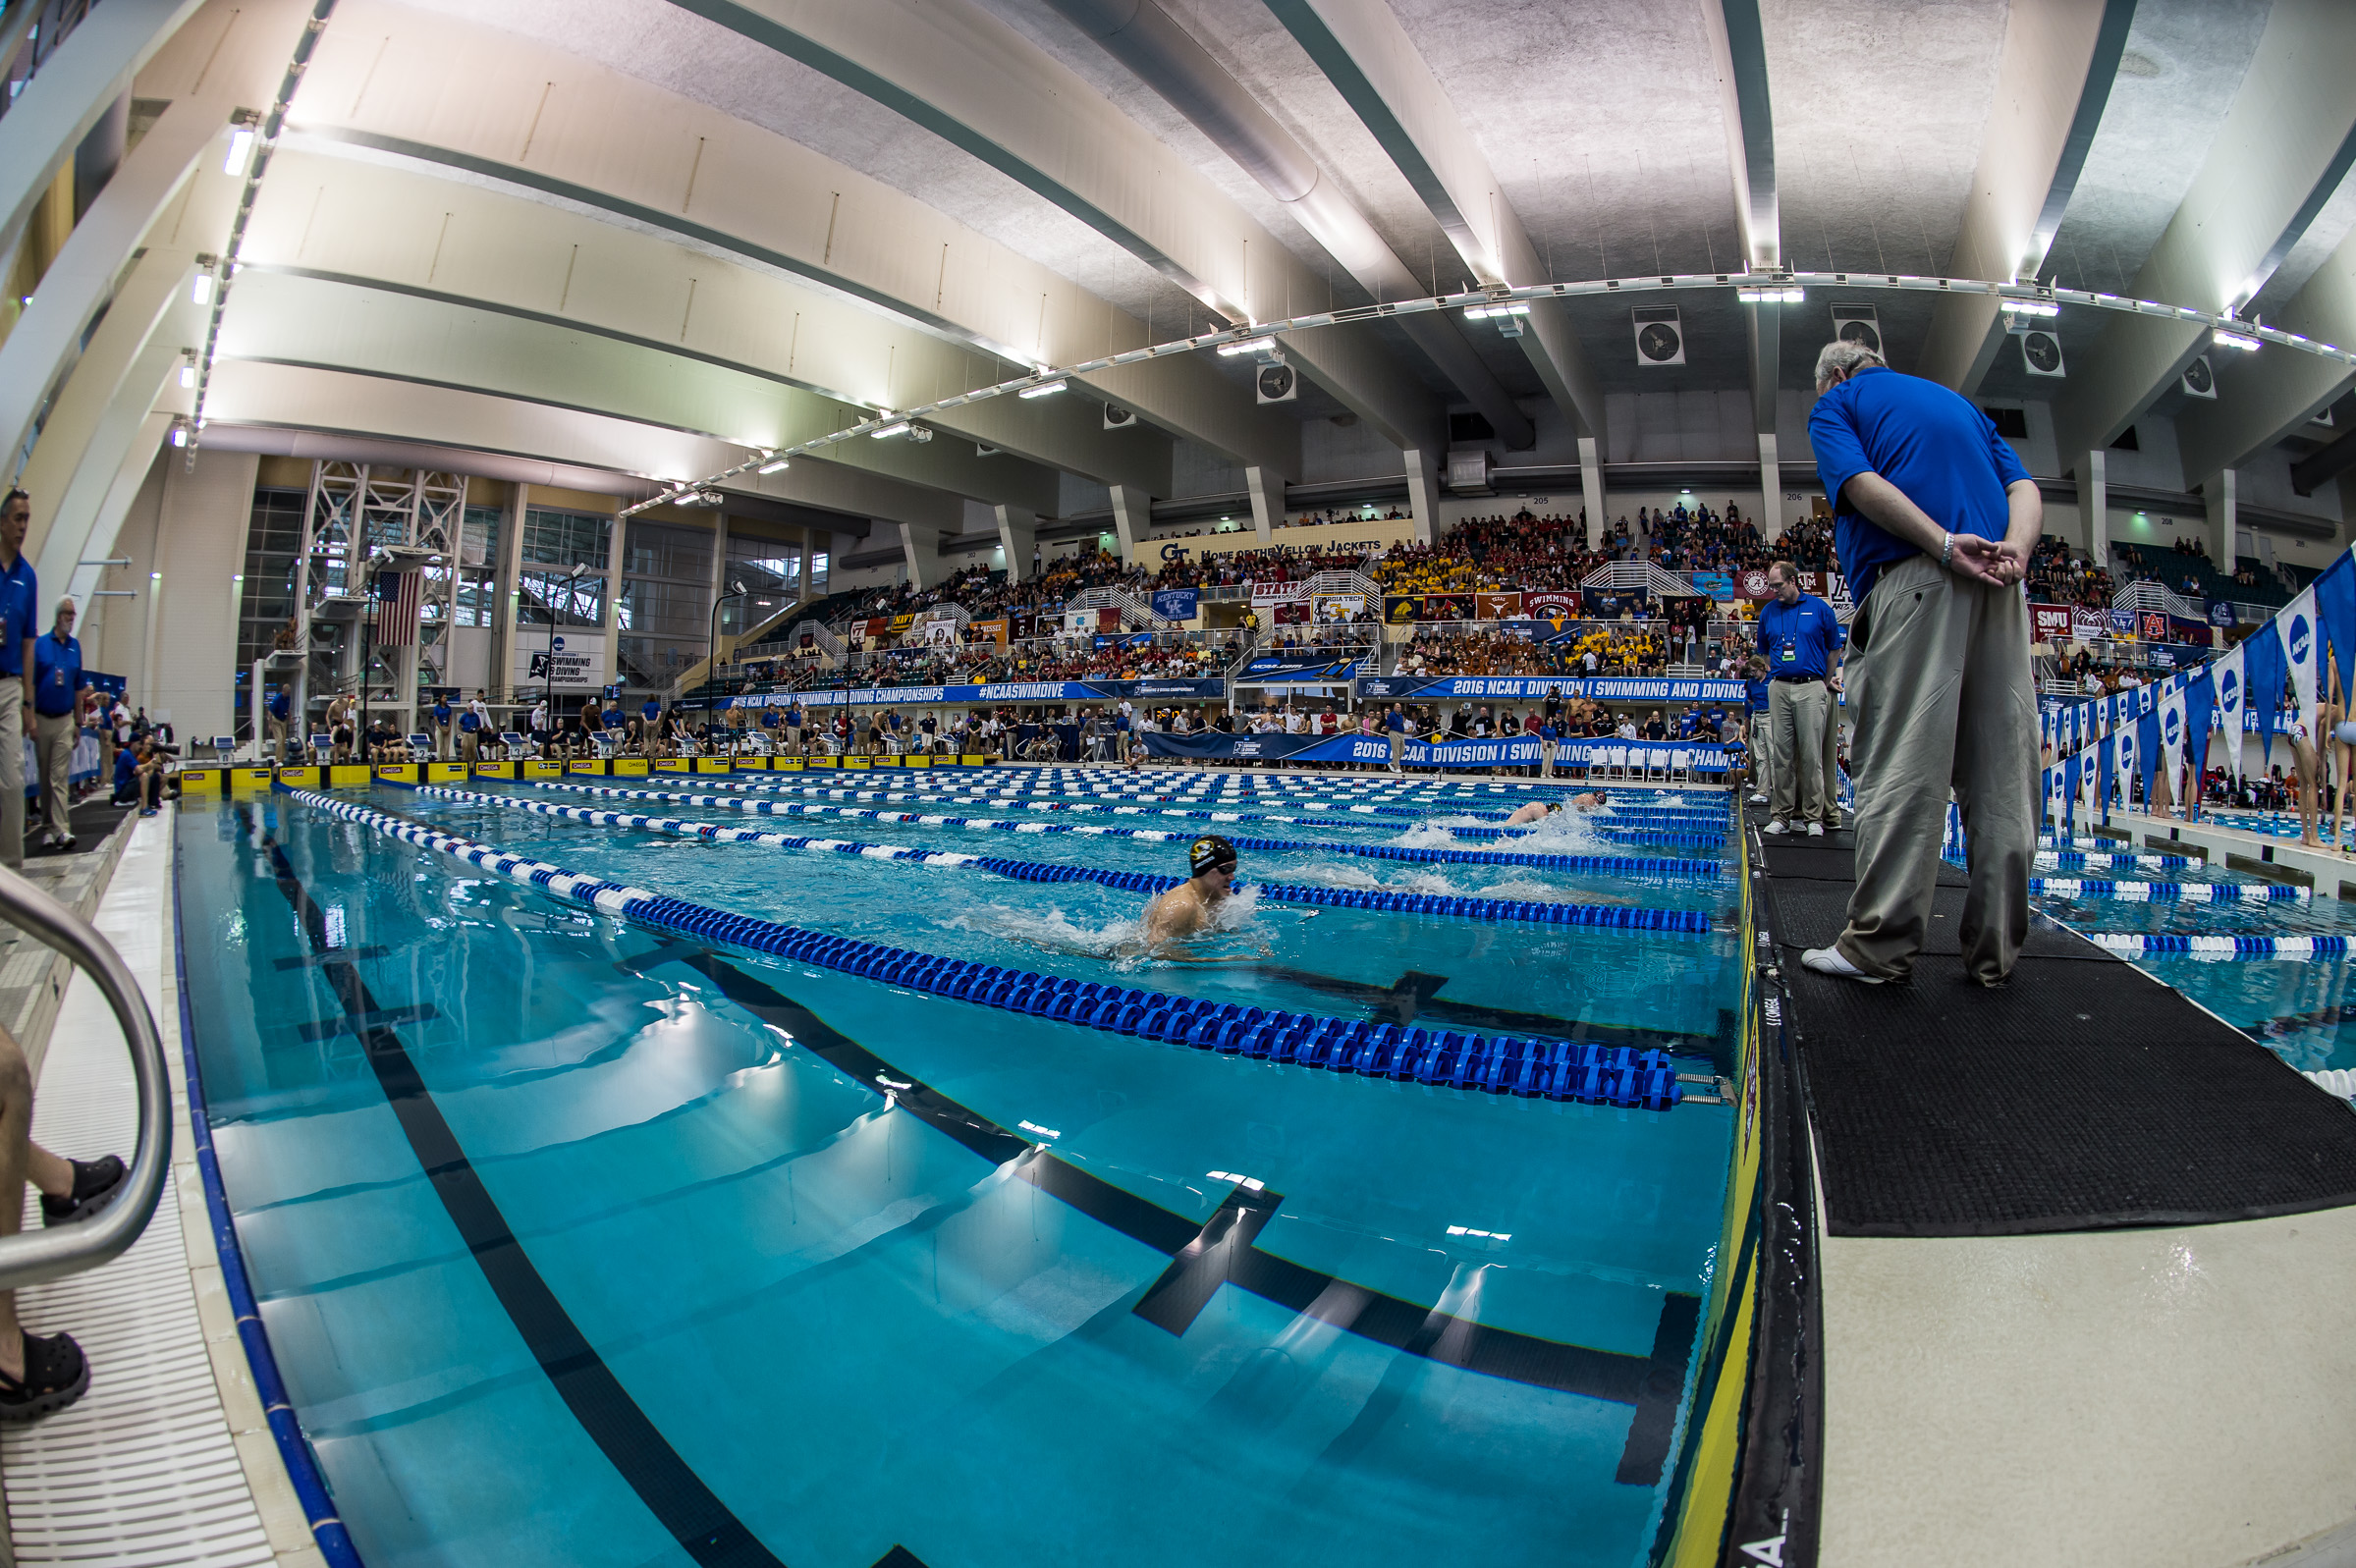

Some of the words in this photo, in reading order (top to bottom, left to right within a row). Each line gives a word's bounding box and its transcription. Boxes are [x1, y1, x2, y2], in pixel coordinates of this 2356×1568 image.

[1327, 540, 1381, 552] JACKETS
[1157, 591, 1195, 603] KENTUCKY
[1529, 594, 1573, 608] SWIMMING
[894, 614, 914, 624] NAVY
[2037, 611, 2068, 627] SMU
[550, 657, 590, 667] SWIMMING
[556, 667, 580, 676] DIVING
[979, 682, 1066, 698] #NCAASWIMDIVE
[1452, 679, 1485, 694] 2016
[1587, 681, 1592, 695] I
[1595, 681, 1669, 696] SWIMMING
[1671, 682, 1699, 697] AND
[1702, 682, 1746, 699] DIVING
[747, 695, 763, 707] NCAA
[764, 694, 792, 707] DIVISION
[796, 692, 832, 705] SWIMMING
[833, 691, 847, 703] AND
[849, 690, 875, 704] DIVING
[875, 687, 944, 703] CHAMPIONSHIPS
[1352, 741, 1388, 758] 2016
[1390, 744, 1427, 762] CAA
[1433, 744, 1498, 762] DIVISION
[1500, 744, 1507, 761] I
